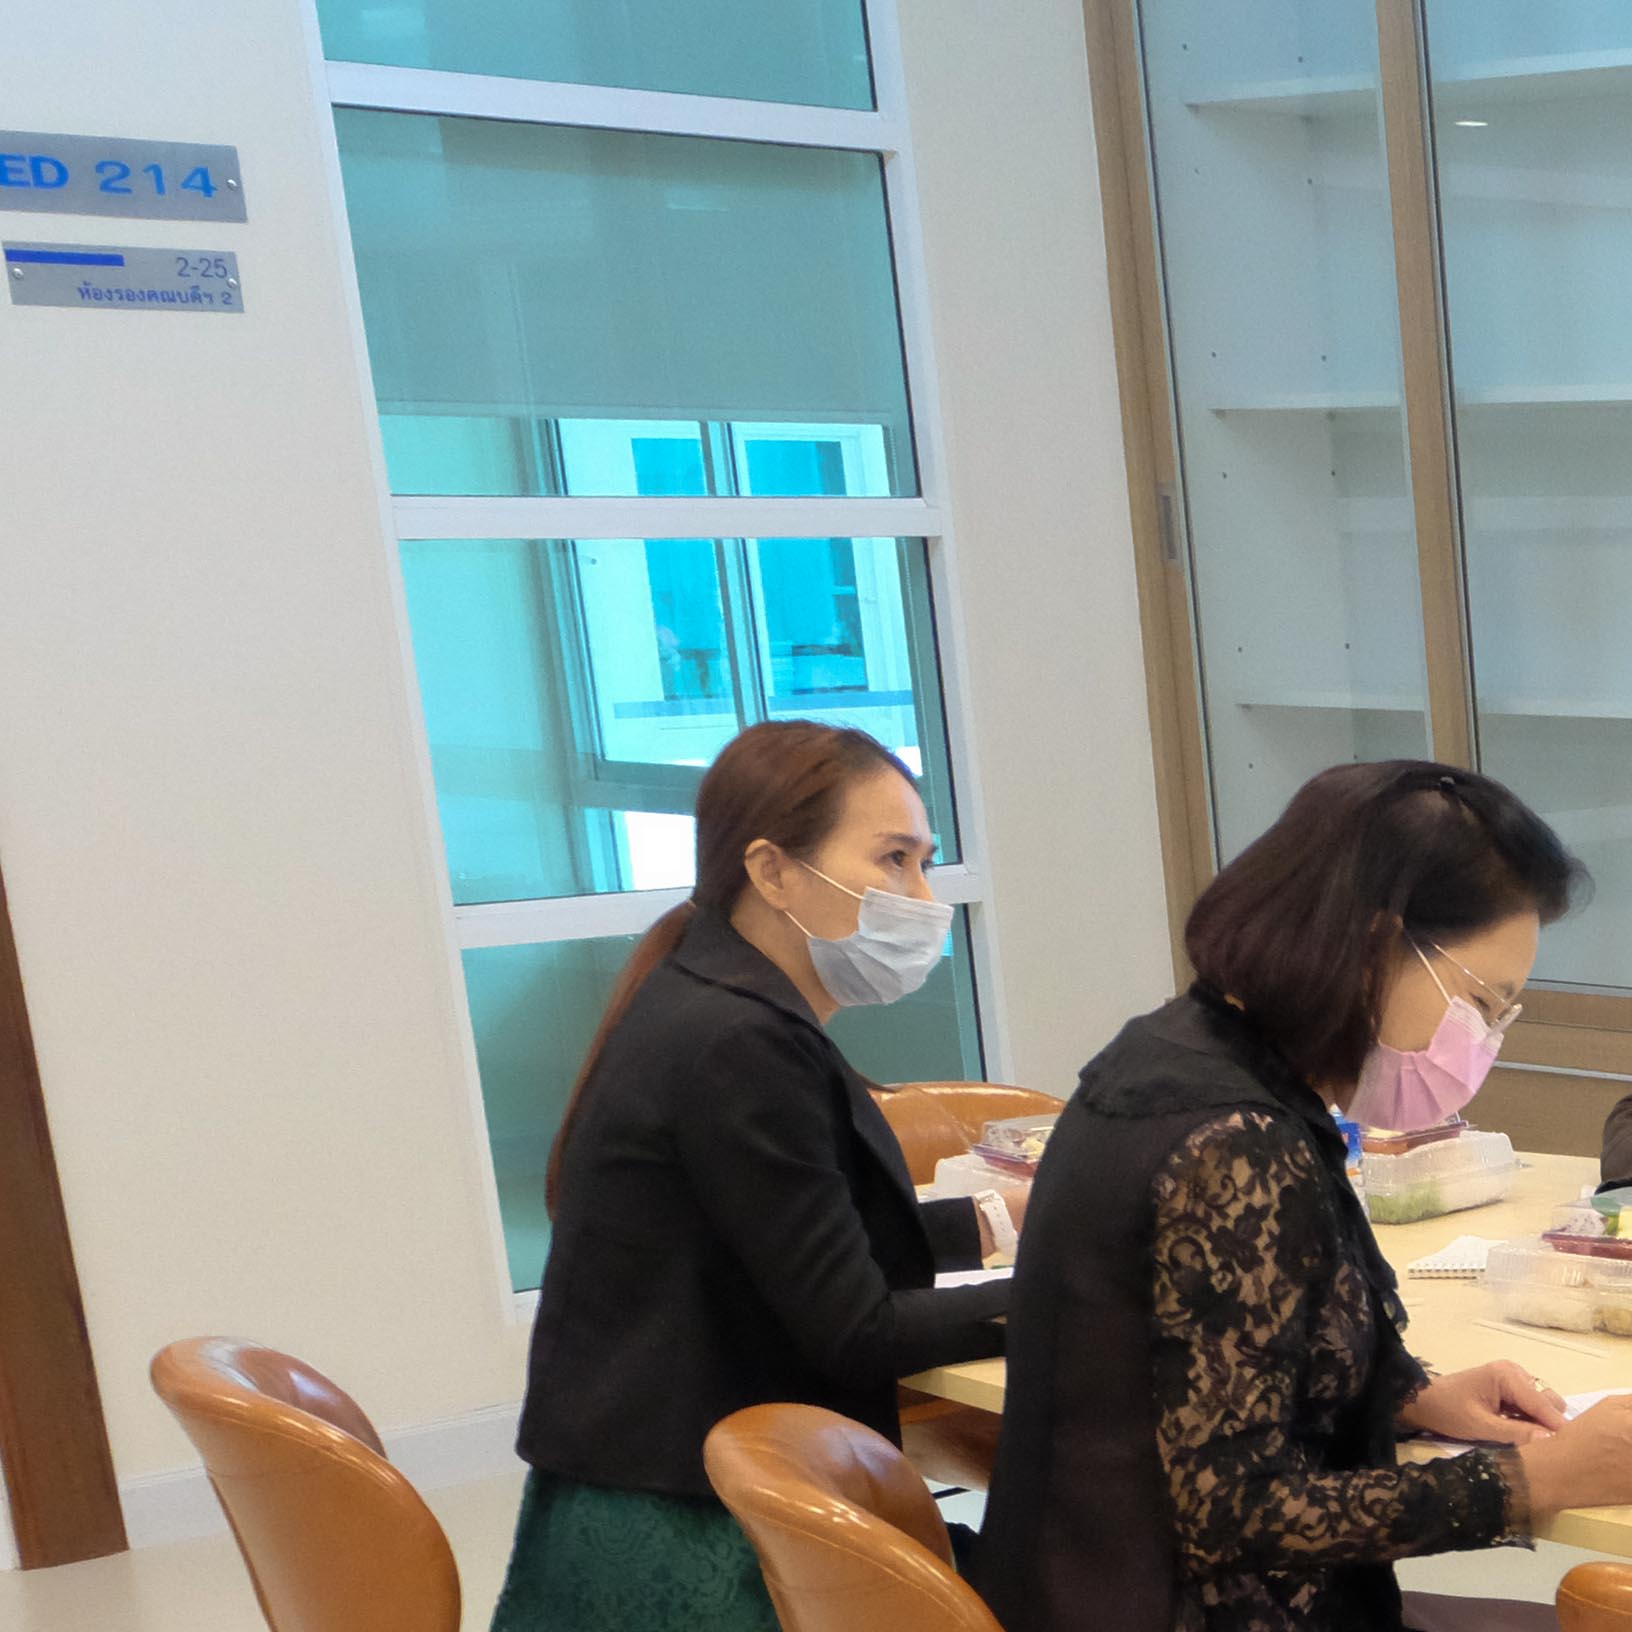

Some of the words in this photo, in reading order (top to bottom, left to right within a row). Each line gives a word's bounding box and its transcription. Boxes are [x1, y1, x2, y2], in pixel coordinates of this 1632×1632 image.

[95, 159, 219, 199] 214
[176, 256, 228, 279] 2-25
[221, 291, 233, 305] 2
